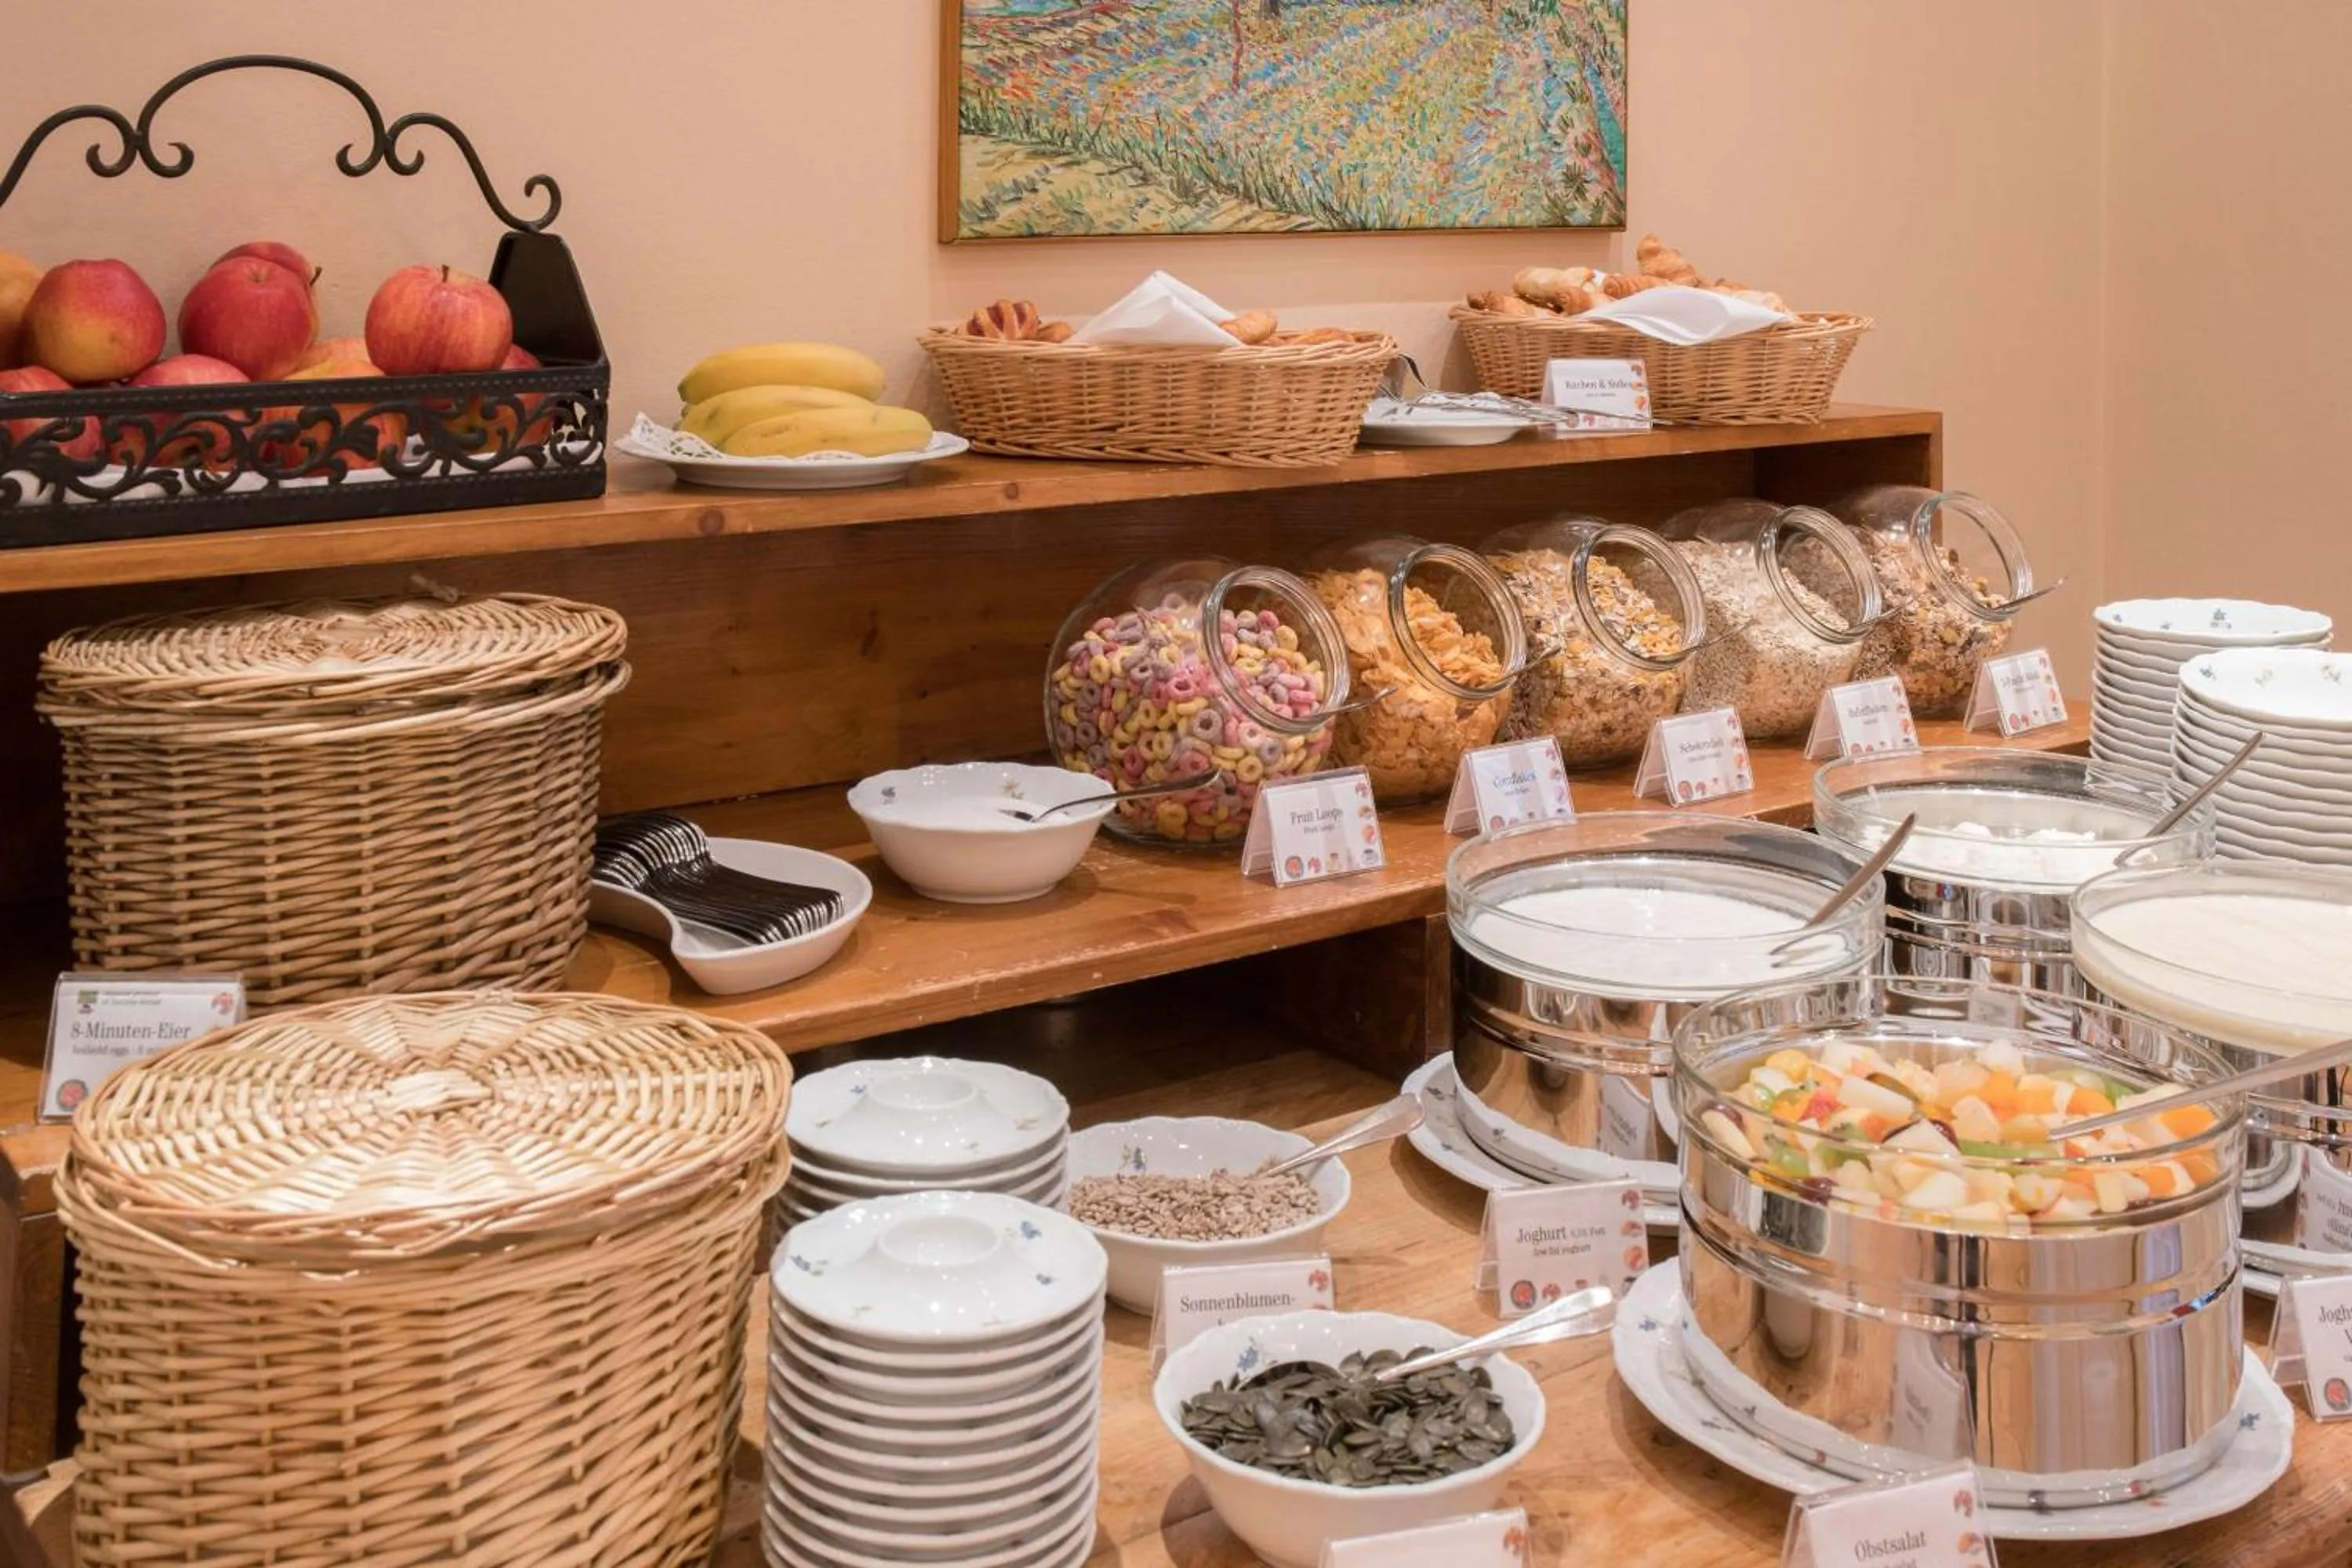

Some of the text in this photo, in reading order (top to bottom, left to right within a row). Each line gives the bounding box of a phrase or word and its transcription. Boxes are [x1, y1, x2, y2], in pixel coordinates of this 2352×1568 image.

[71, 1021, 192, 1040] 8-Minuten-Eier
[1516, 1226, 1566, 1245] Joghurt
[1180, 1292, 1296, 1313] Sonnenblumen-
[1854, 1530, 1928, 1563] Obstsalat
